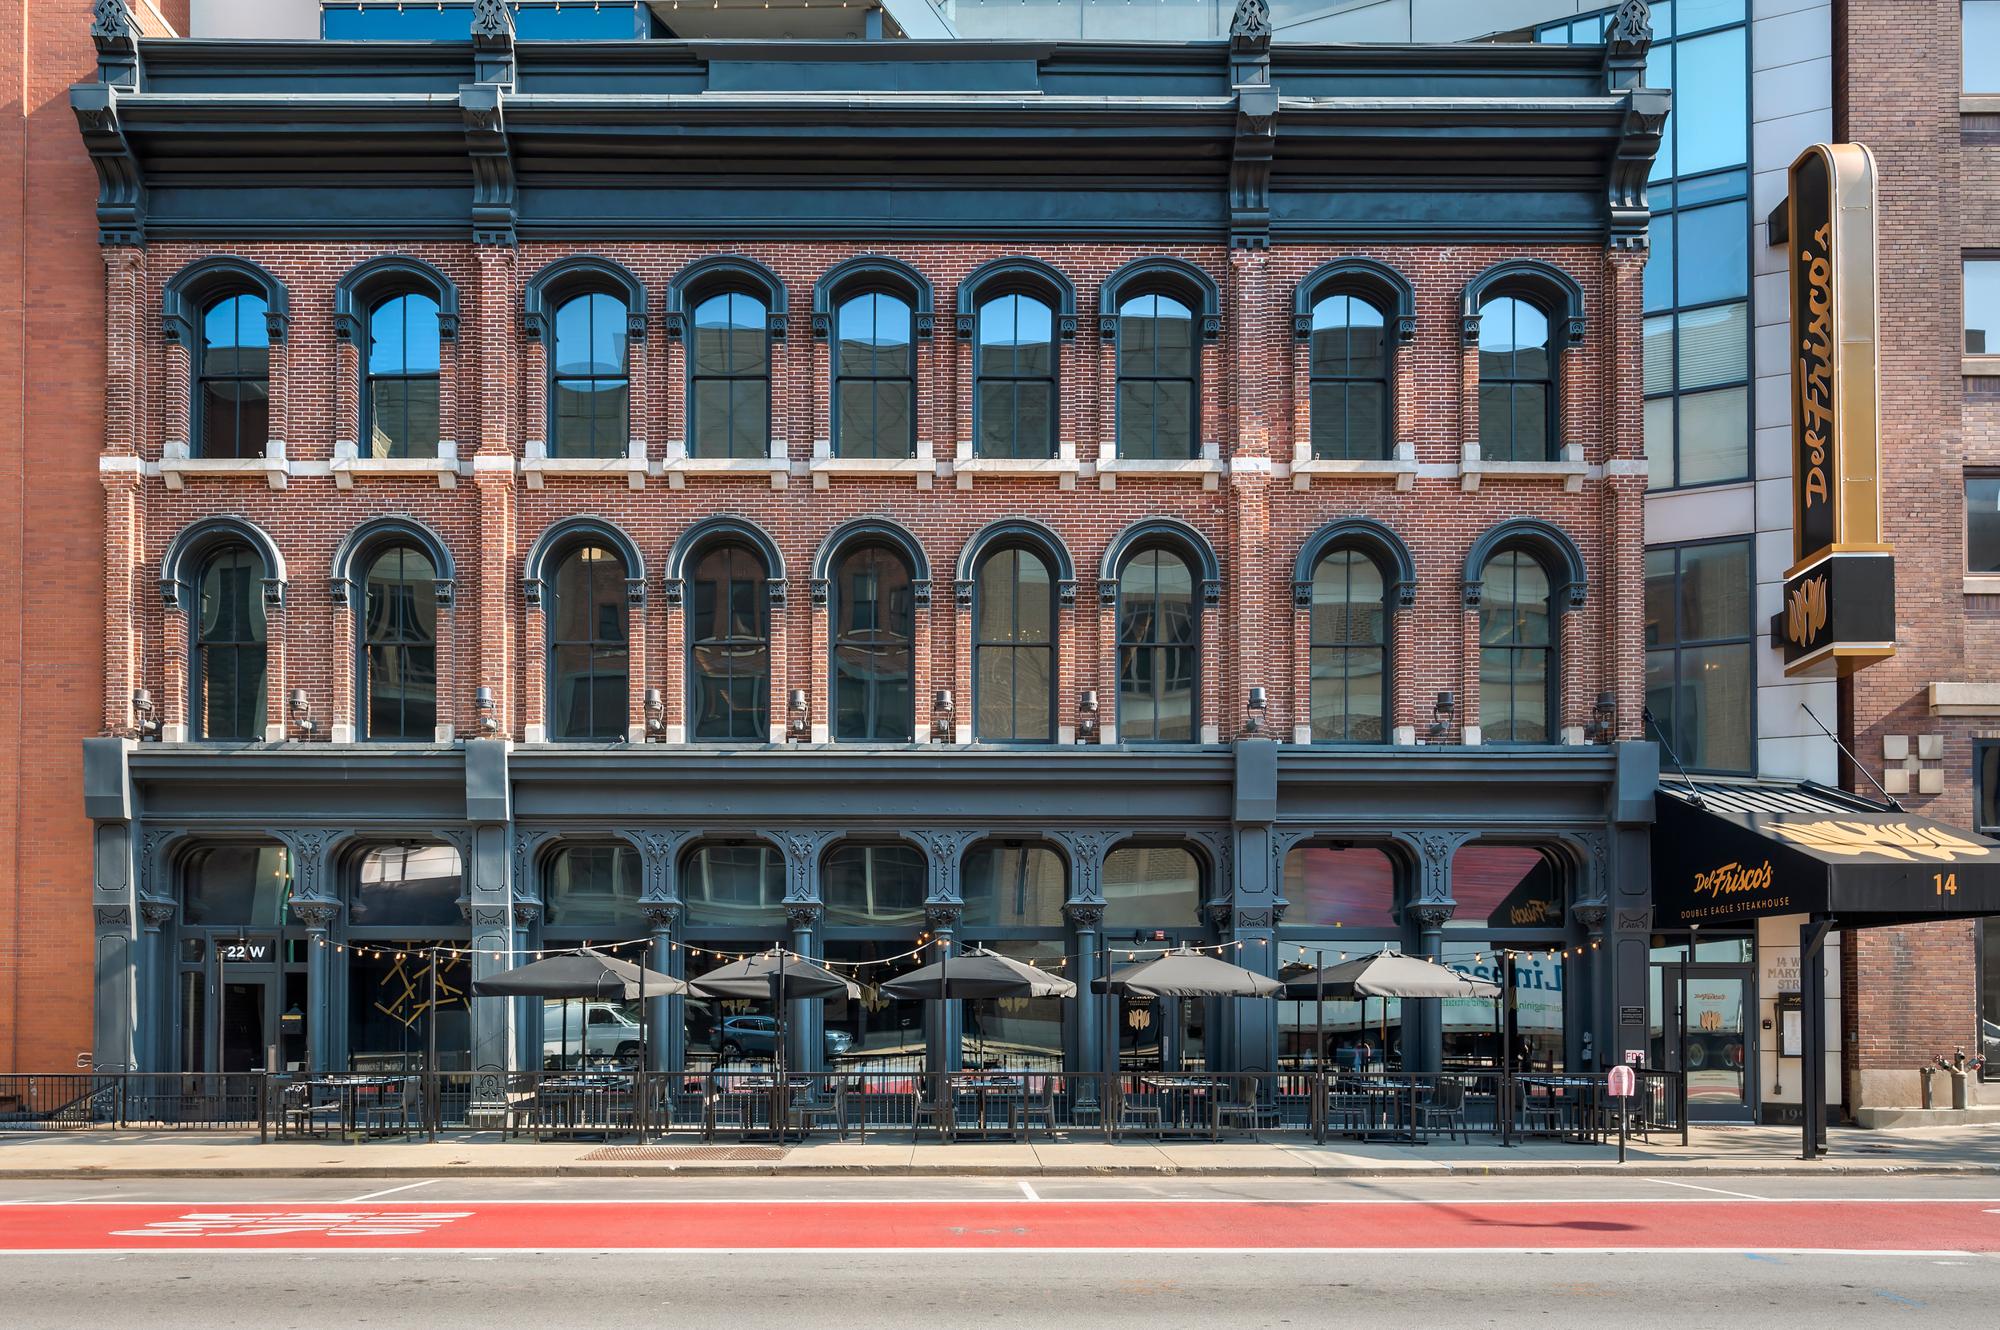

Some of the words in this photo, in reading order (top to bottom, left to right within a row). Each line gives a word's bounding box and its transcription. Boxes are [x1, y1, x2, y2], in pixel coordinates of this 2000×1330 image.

[1933, 873, 1957, 896] 14
[1680, 906, 1708, 919] DOUBLE
[1710, 903, 1734, 916] EAGLE
[1736, 896, 1790, 912] STEAKHOUSE
[227, 946, 245, 958] 22
[250, 946, 265, 958] W
[1776, 957, 1787, 967] 14
[108, 1212, 476, 1237] BUS
